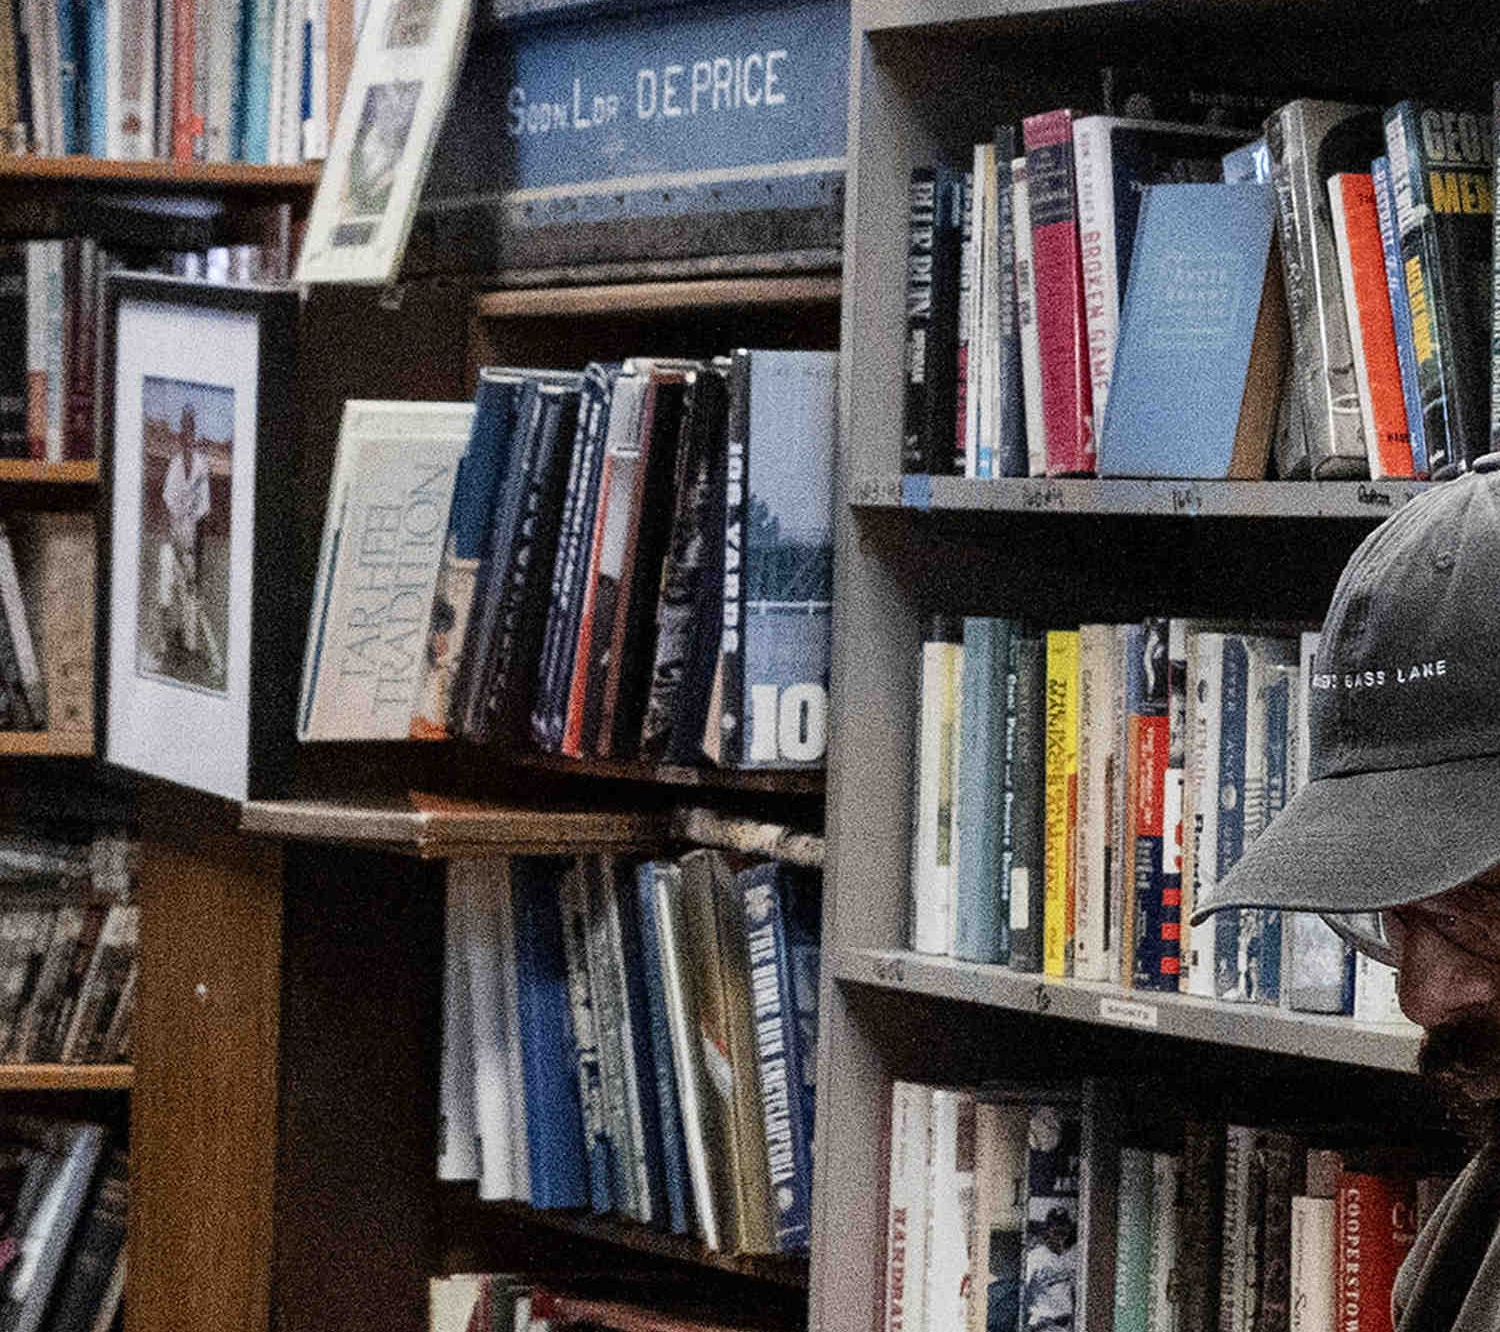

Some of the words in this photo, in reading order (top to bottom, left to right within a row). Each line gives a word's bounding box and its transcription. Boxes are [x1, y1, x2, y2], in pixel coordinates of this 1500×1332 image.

[1081, 231, 1104, 318] BROKEN
[1086, 327, 1108, 394] GAME
[370, 462, 449, 717] TRADITION
[1396, 659, 1447, 684] LAKE
[751, 963, 780, 1017] HOME
[760, 1058, 794, 1184] ENCYCLOPEDIA
